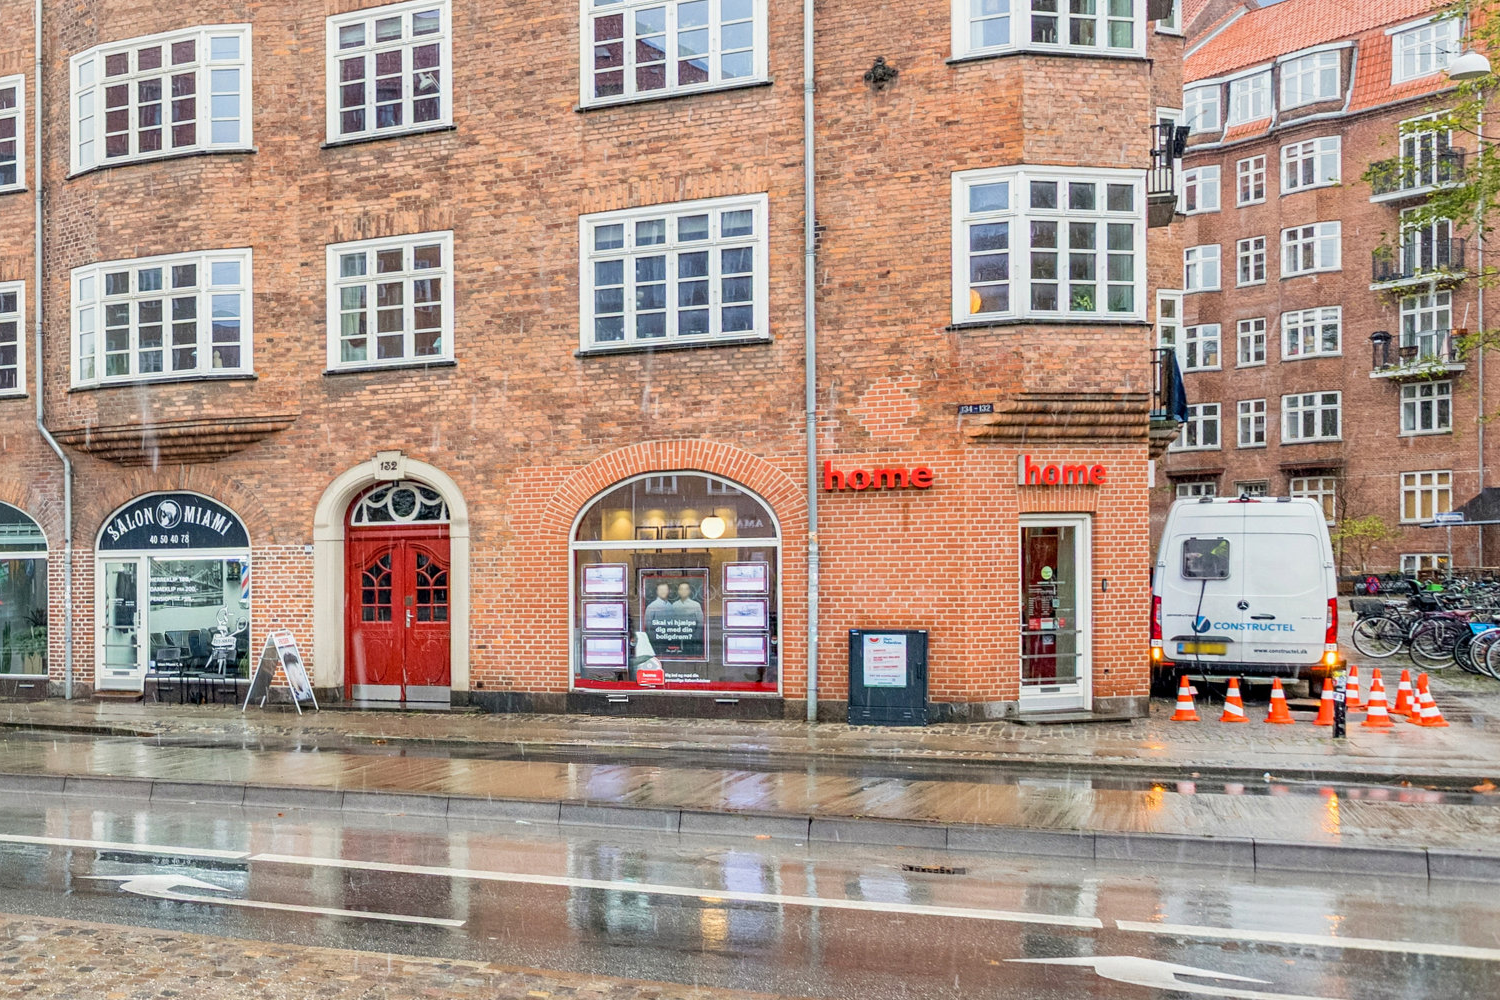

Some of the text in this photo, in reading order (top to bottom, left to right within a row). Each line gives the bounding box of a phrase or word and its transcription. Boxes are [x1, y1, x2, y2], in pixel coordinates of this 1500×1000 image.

[380, 461, 397, 471] 132
[1024, 455, 1107, 485] home
[824, 460, 933, 490] home
[107, 505, 233, 541] SALON MIAMI
[149, 534, 190, 544] 40 50 40 78
[674, 619, 697, 627] hjælpe
[1213, 621, 1296, 632] CONSTRUCTEL
[655, 633, 693, 641] boligdrøm?
[1253, 647, 1308, 655] www.constructel.dk
